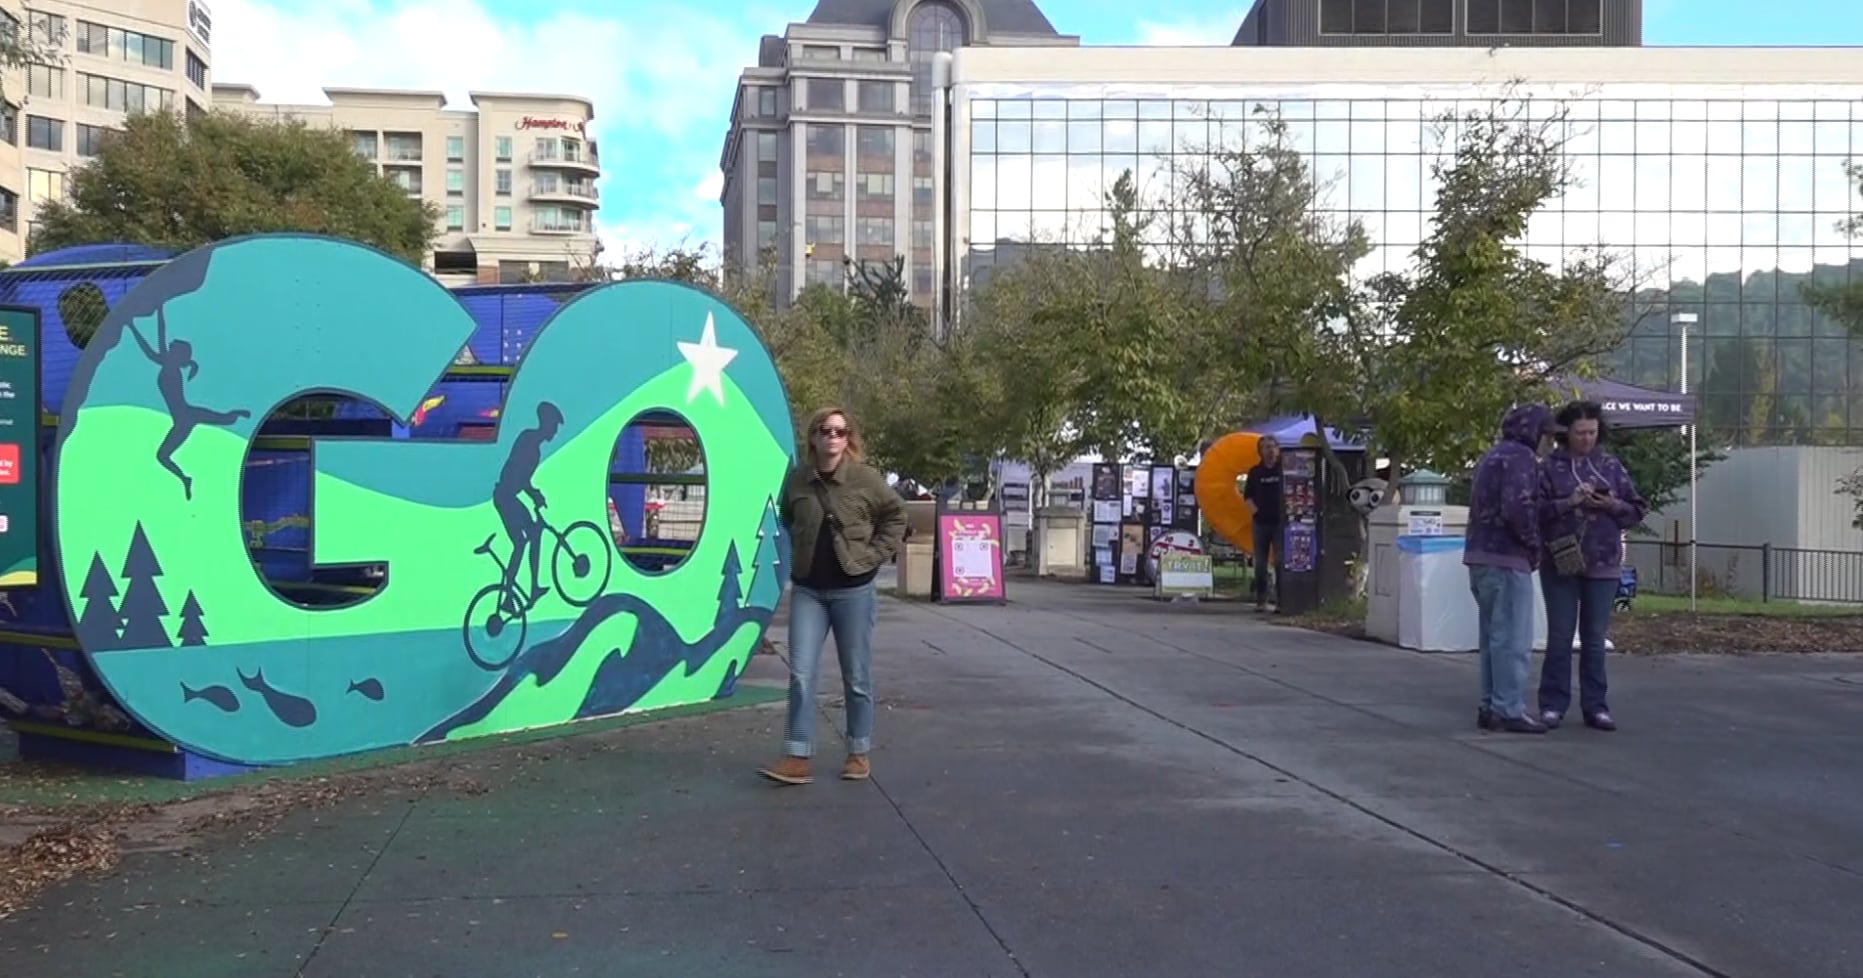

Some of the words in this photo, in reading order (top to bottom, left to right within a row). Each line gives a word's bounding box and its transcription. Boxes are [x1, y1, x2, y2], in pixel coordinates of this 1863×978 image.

[56, 232, 796, 766] GO
[1618, 402, 1631, 411] WE
[1633, 402, 1656, 412] WANT
[1658, 403, 1669, 412] TO
